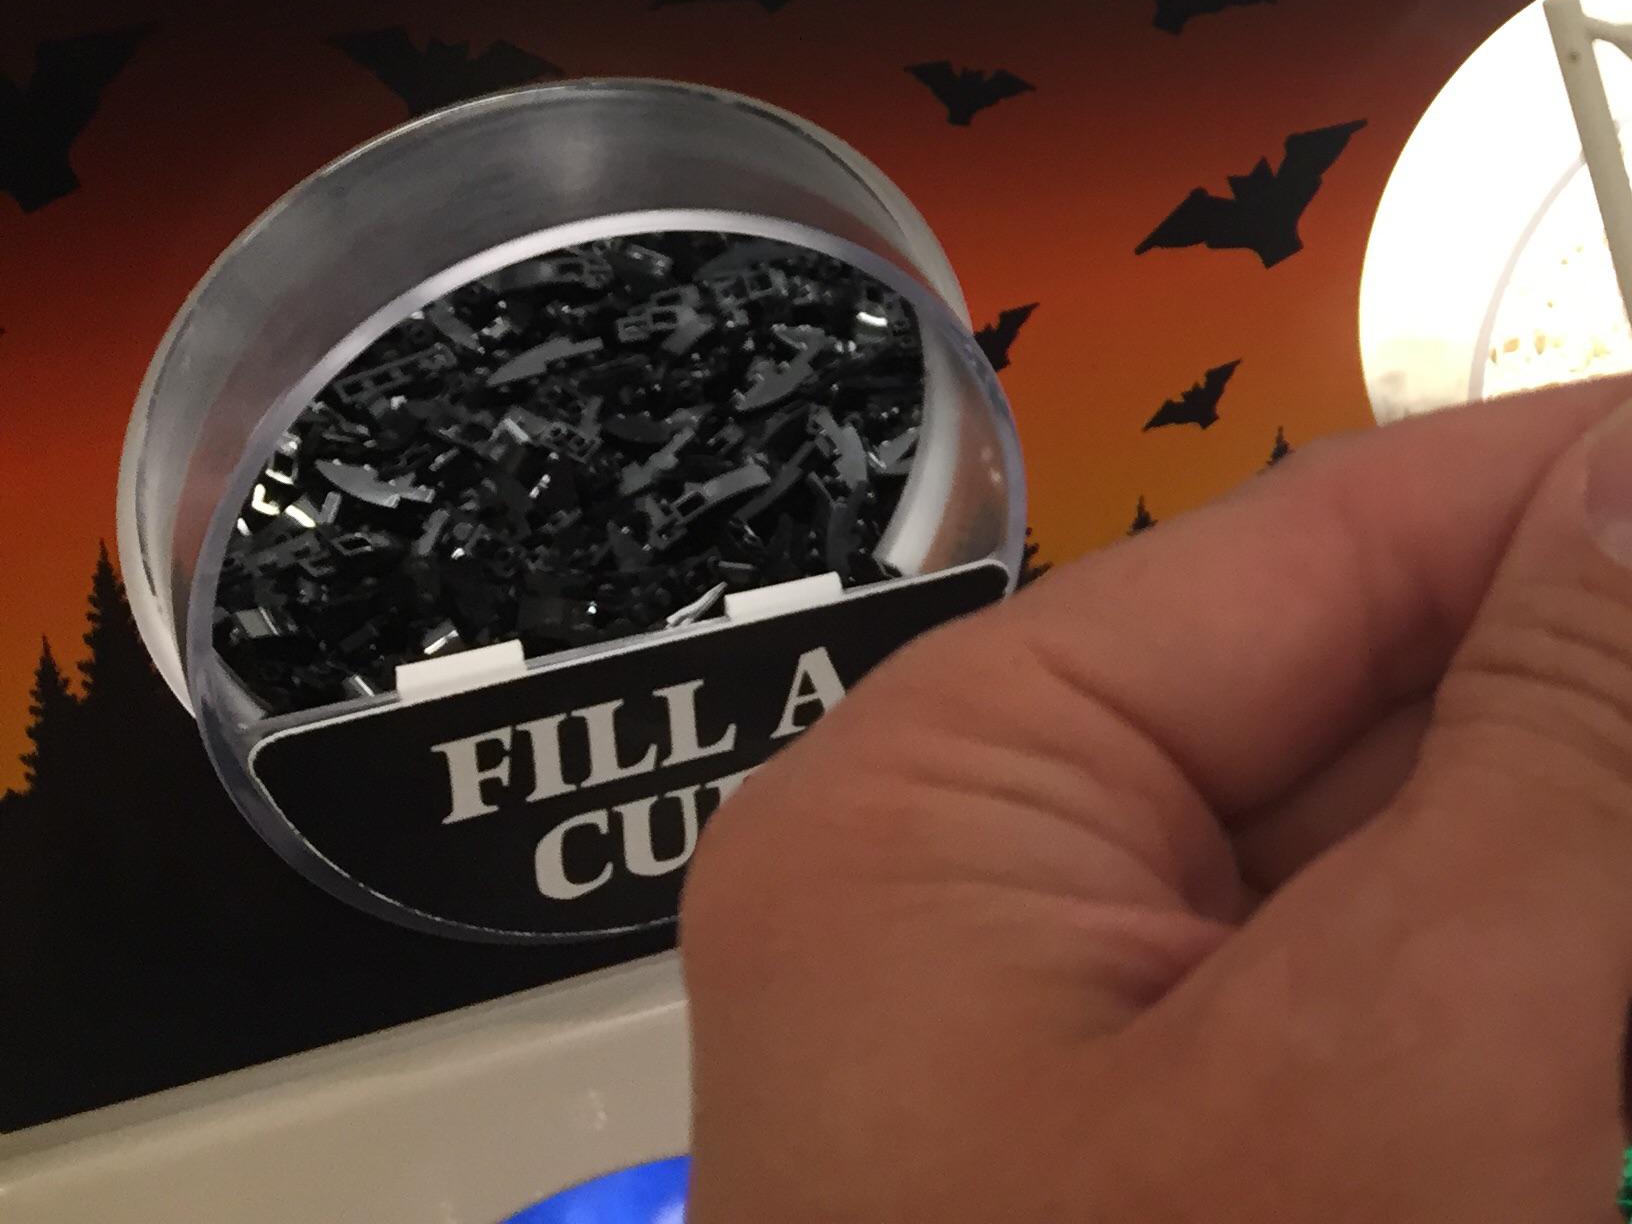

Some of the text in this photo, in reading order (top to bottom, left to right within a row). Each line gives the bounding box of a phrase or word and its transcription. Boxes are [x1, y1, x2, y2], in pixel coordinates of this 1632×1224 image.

[430, 645, 847, 825] FILL A
[533, 764, 764, 901] CU
